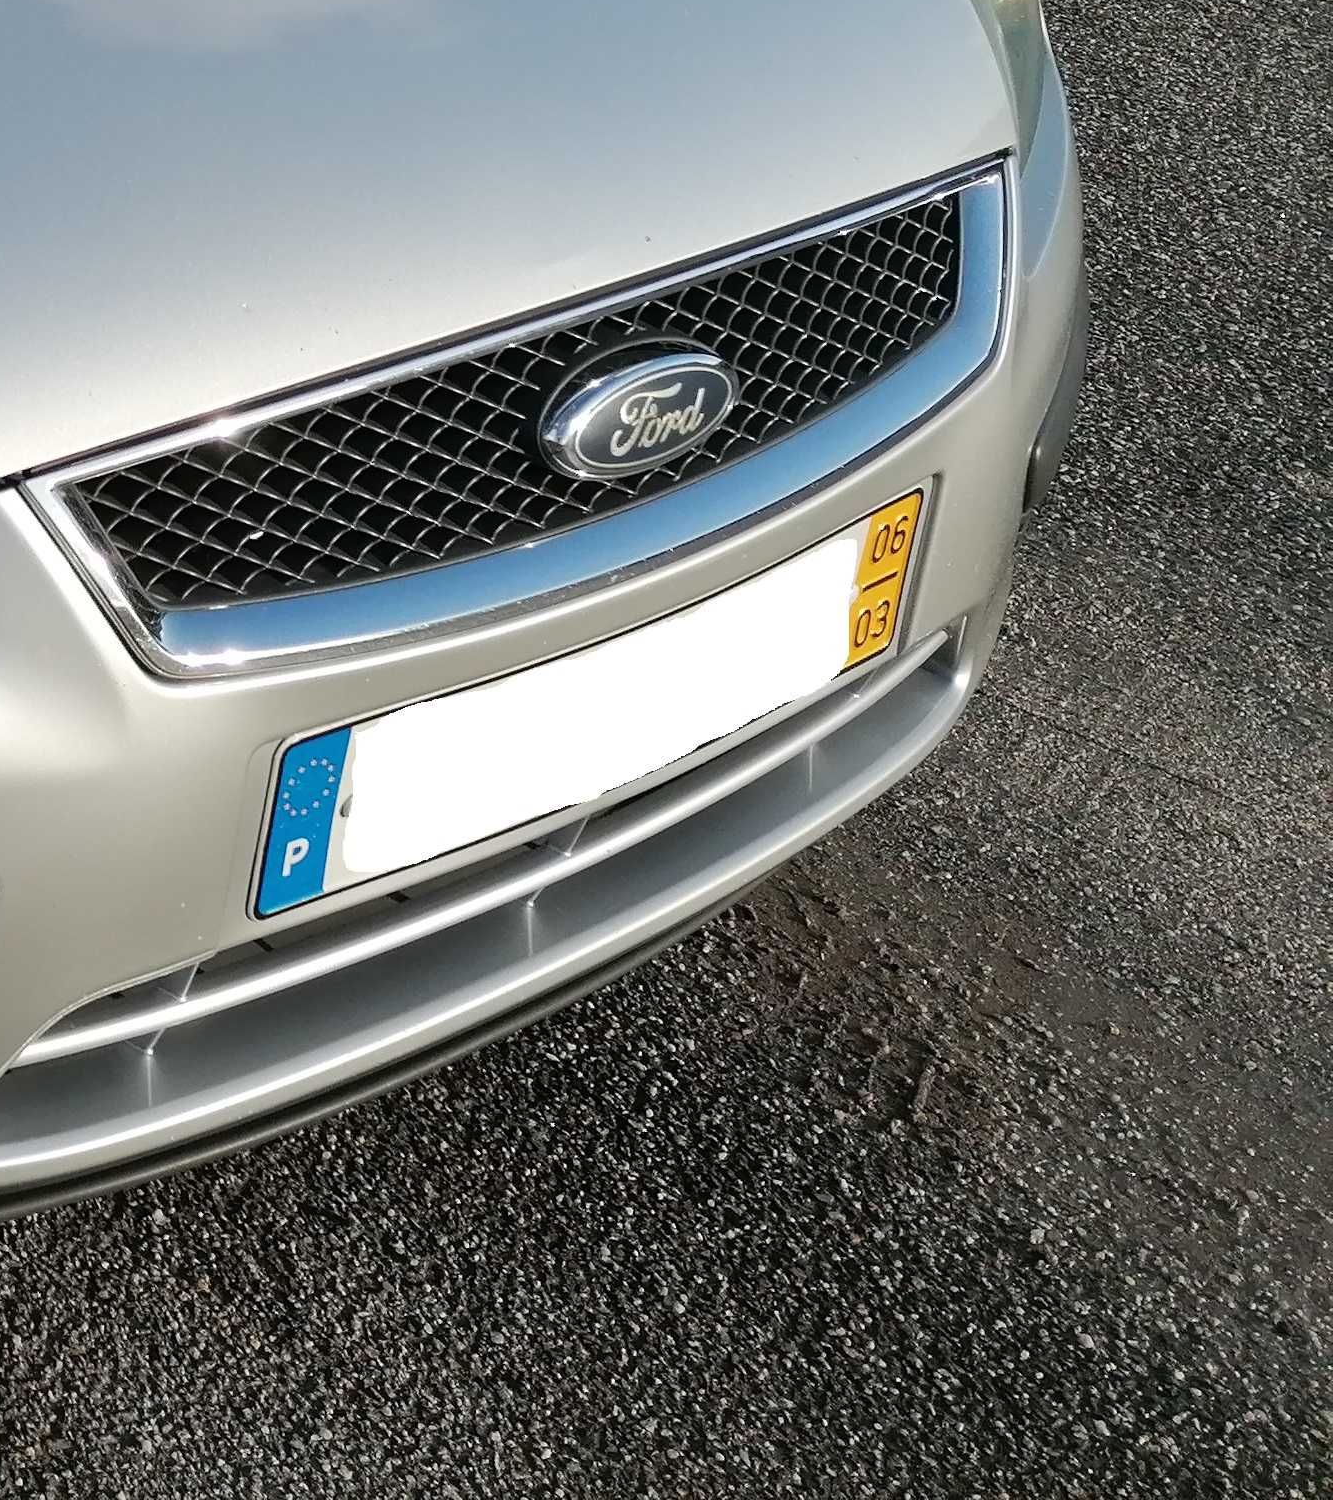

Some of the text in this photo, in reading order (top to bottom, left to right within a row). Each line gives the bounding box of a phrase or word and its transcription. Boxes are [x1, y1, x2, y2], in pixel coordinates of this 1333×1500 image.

[610, 382, 706, 457] Ford
[871, 515, 909, 564] 06
[854, 599, 891, 648] 03
[282, 837, 310, 877] P
